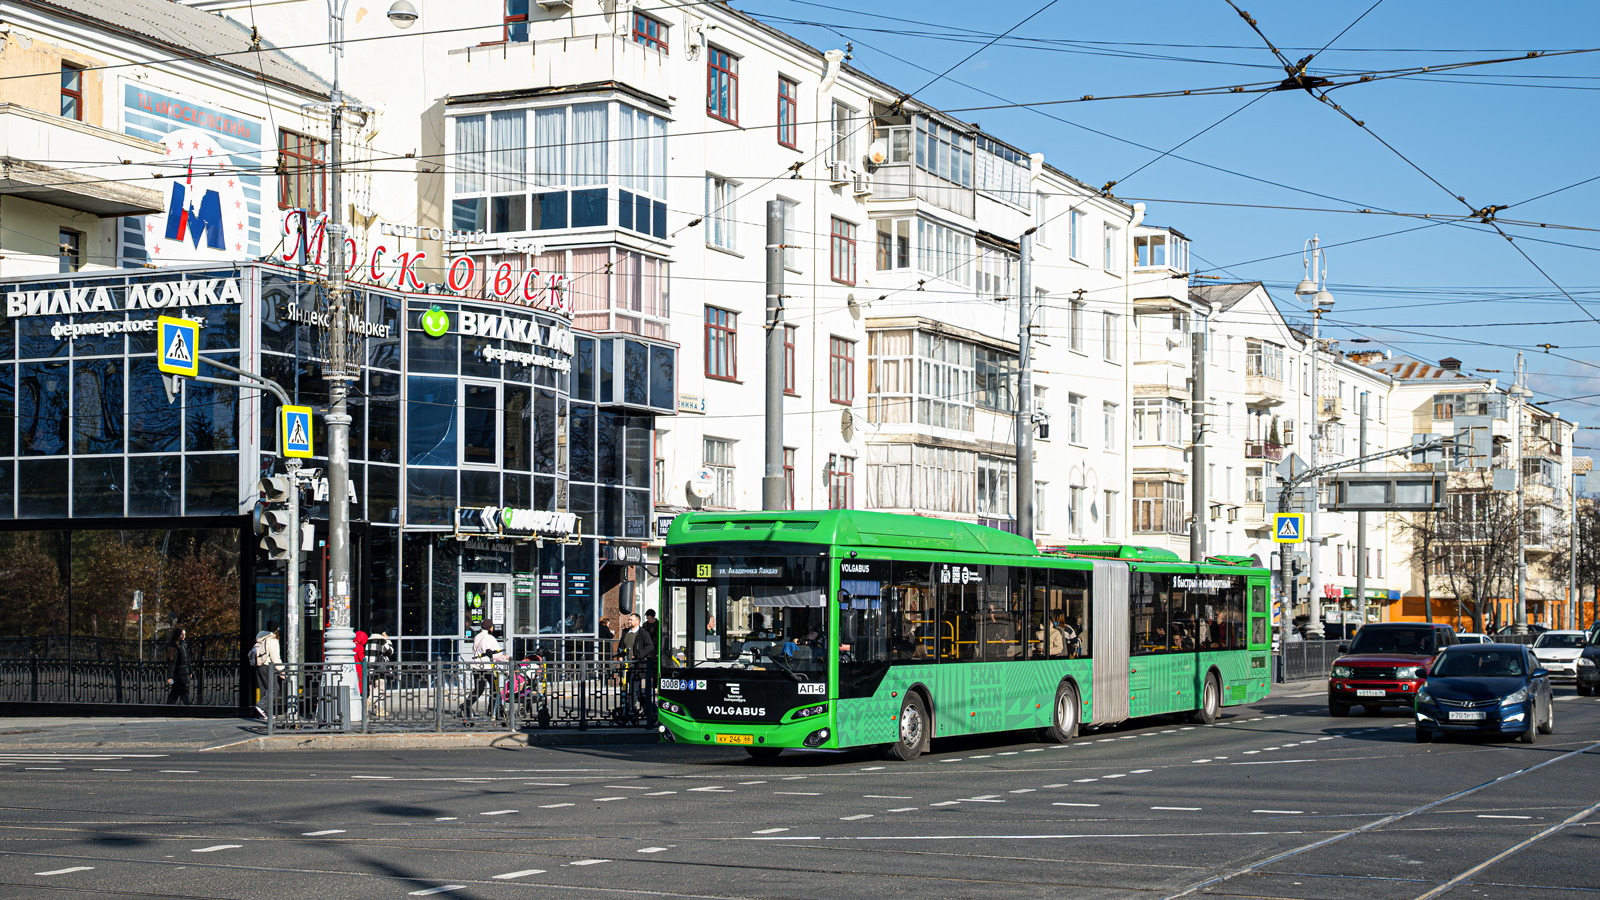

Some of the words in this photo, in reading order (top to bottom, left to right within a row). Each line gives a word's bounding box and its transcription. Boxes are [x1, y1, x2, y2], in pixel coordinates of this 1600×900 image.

[138, 93, 152, 113] ТЦ
[155, 100, 250, 139] «МОСКОВСКИЙ»
[6, 285, 117, 317] ВИЛКА
[127, 277, 243, 310] ЛОЖКА
[287, 302, 329, 328] Яндекс
[349, 313, 391, 338] Маркет
[51, 319, 154, 341] фермерское
[460, 310, 542, 346] ВИЛКА
[701, 398, 705, 411] 5
[698, 565, 709, 577] 51
[728, 567, 757, 575] Академика
[841, 563, 870, 573] VOLGABUS
[661, 679, 679, 689] 3008
[799, 684, 825, 694] АП-6
[706, 705, 766, 717] VOLGABUS
[729, 735, 741, 743] 246
